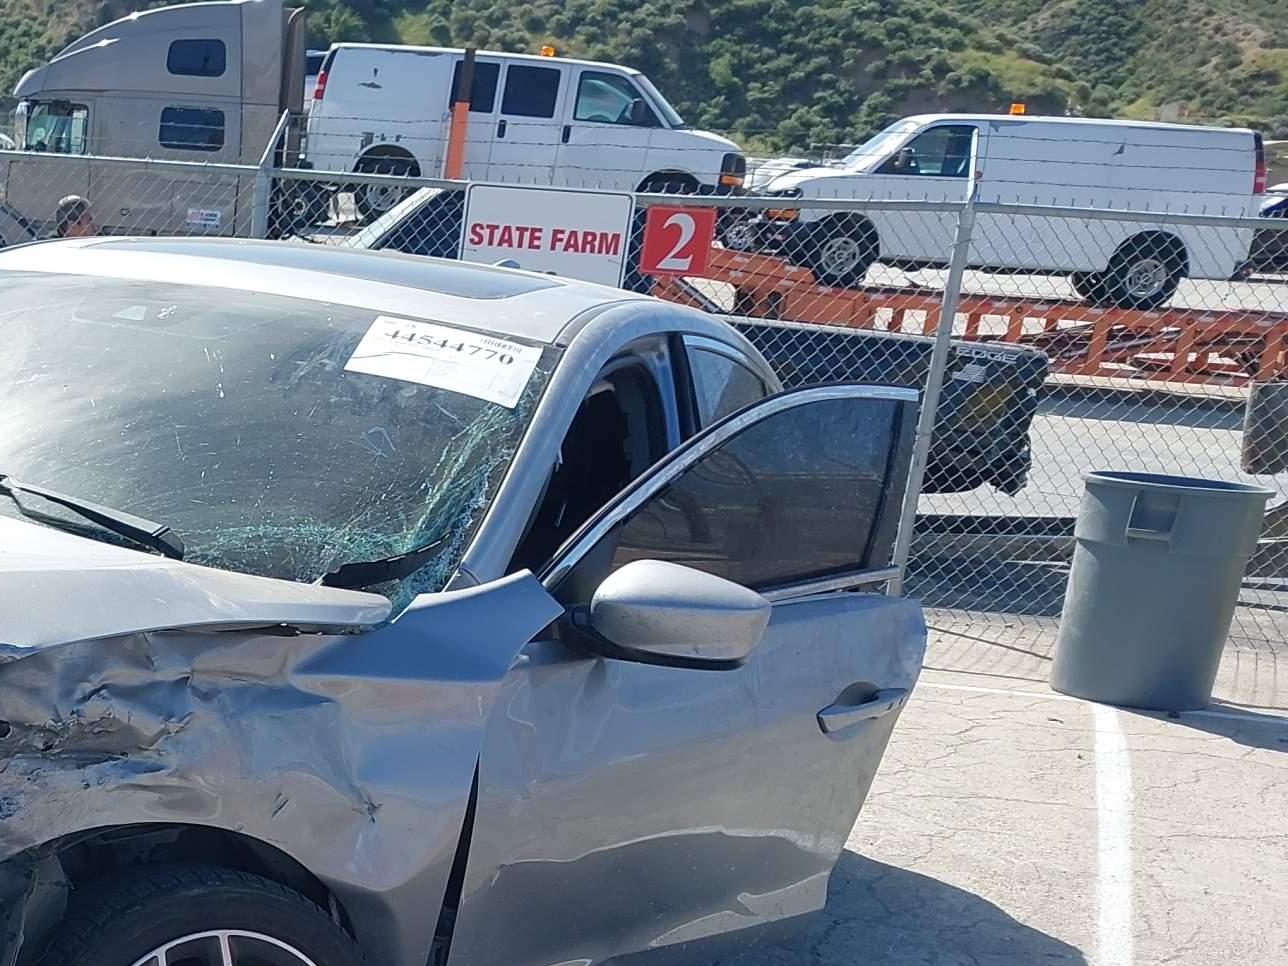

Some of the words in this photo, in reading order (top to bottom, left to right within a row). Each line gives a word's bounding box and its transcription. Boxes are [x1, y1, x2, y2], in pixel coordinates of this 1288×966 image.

[469, 223, 543, 250] STATE
[550, 228, 621, 256] FARM
[655, 213, 696, 271] 2
[384, 329, 514, 366] 44544770
